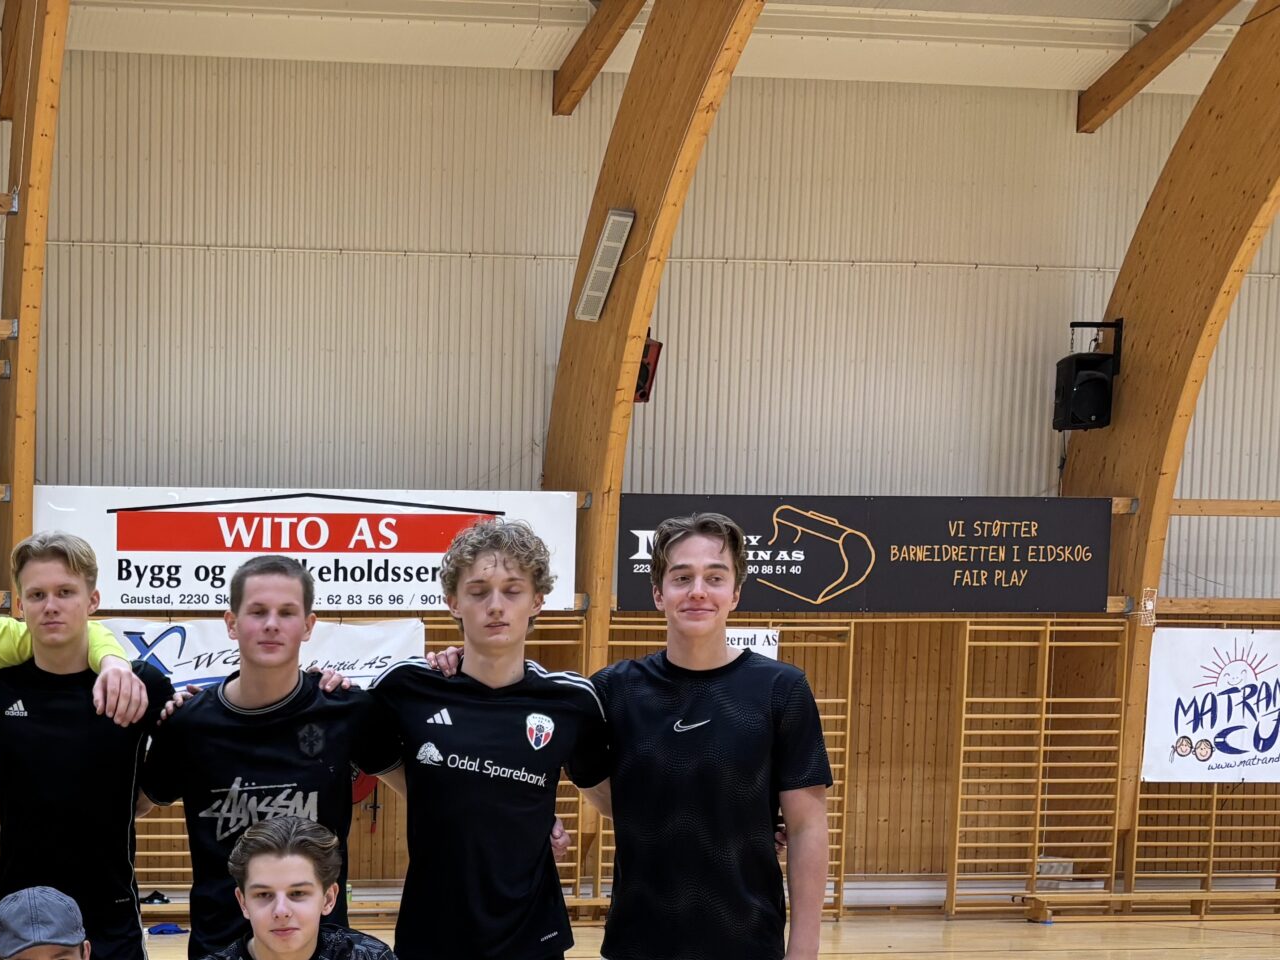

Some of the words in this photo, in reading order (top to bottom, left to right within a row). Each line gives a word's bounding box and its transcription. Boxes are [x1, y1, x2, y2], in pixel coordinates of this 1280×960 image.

[217, 516, 330, 550] WITO
[348, 516, 399, 549] AS
[948, 520, 966, 537] VI
[973, 519, 1038, 538] STØTTER
[775, 550, 805, 561] AS
[890, 544, 1005, 563] BARNEIDRETTEN
[1012, 545, 1021, 562] I
[1027, 544, 1093, 562] EIDSKOG
[117, 558, 182, 588] Bygg
[194, 564, 226, 589] og
[747, 564, 759, 574] 90
[761, 564, 773, 574] 88
[775, 565, 787, 574] 51
[789, 565, 801, 575] 40
[953, 569, 988, 587] FAIR
[994, 569, 1028, 587] PLAY
[120, 593, 174, 607] Gaustad,
[179, 593, 209, 605] 2230
[326, 594, 342, 605] 62
[346, 594, 362, 605] 83
[367, 594, 383, 605] 56
[388, 594, 404, 605] 96
[420, 594, 442, 605] 901
[762, 634, 778, 646] AS
[360, 655, 392, 670] AS
[1214, 711, 1280, 755] CU
[447, 754, 480, 773] Odal
[482, 760, 548, 788] Sparebank
[1208, 753, 1280, 771] www.matrand
